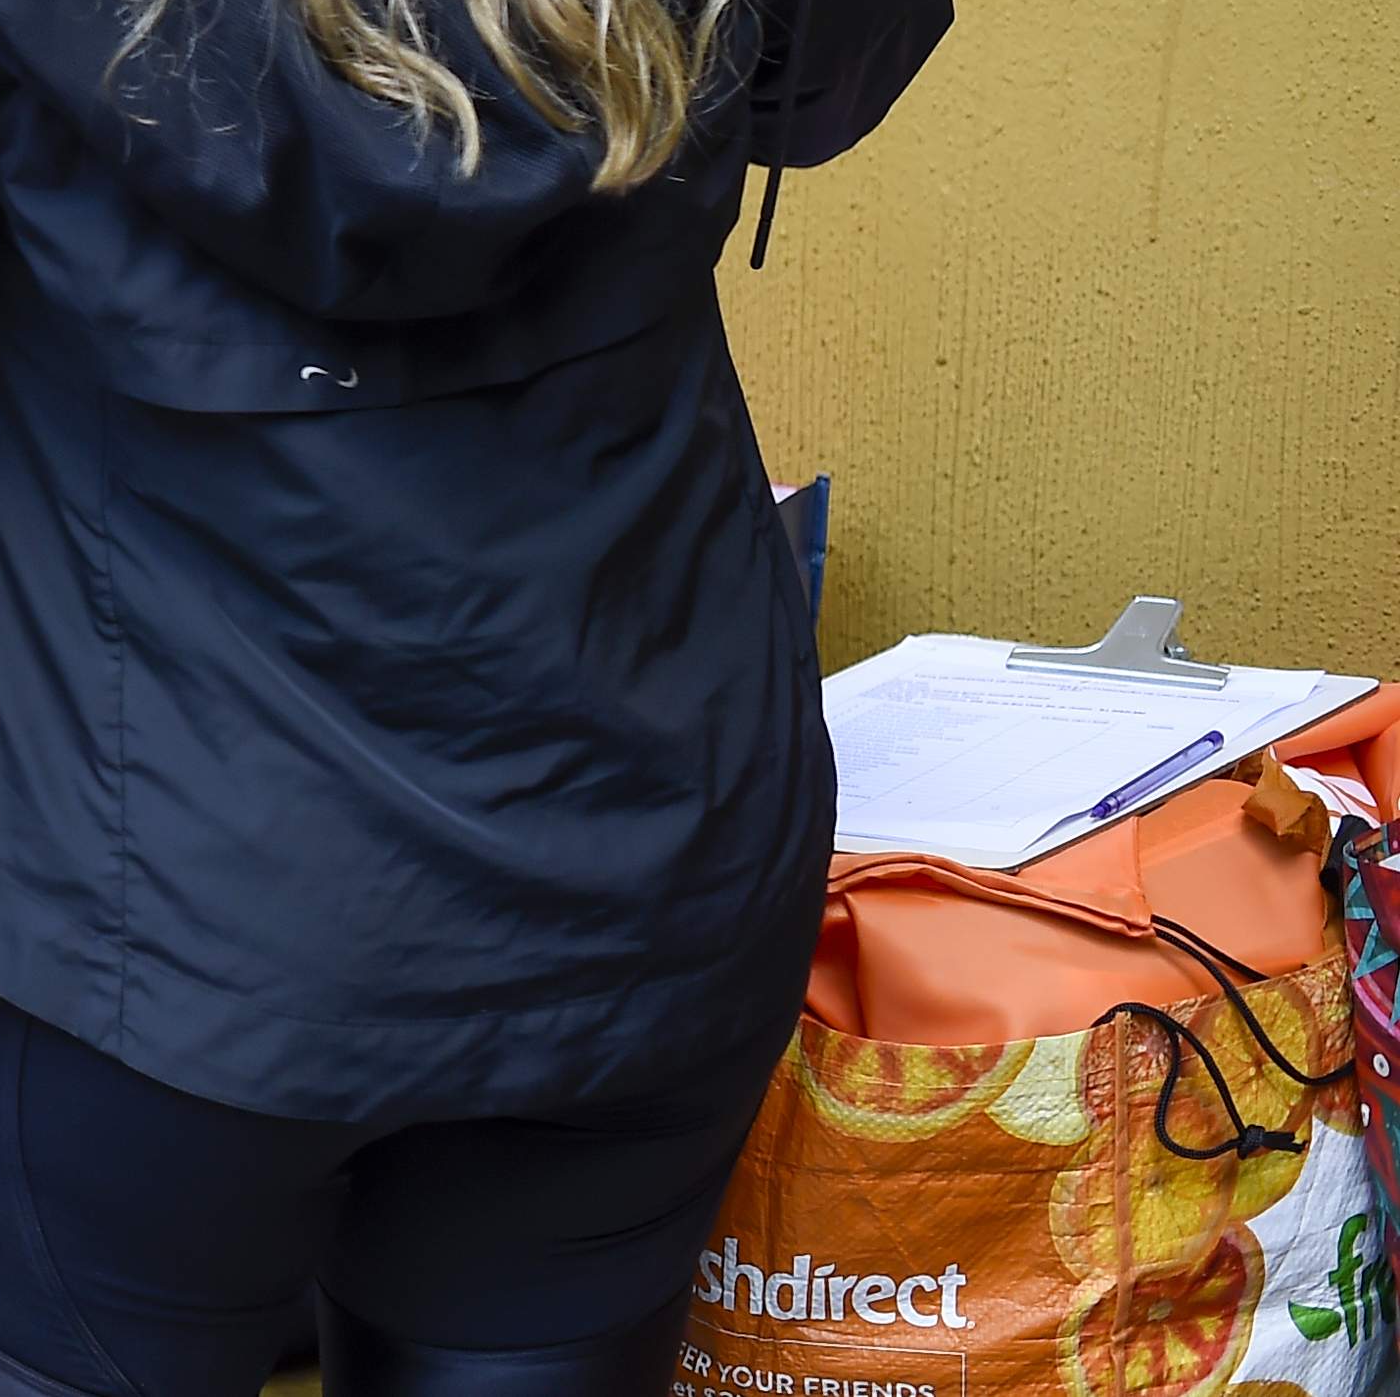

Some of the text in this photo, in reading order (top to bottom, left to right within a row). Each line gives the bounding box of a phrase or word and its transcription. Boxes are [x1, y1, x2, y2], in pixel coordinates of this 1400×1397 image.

[694, 1237, 967, 1329] shdirect
[717, 1360, 794, 1395] YOUR
[804, 1376, 935, 1397] FRIENDS
